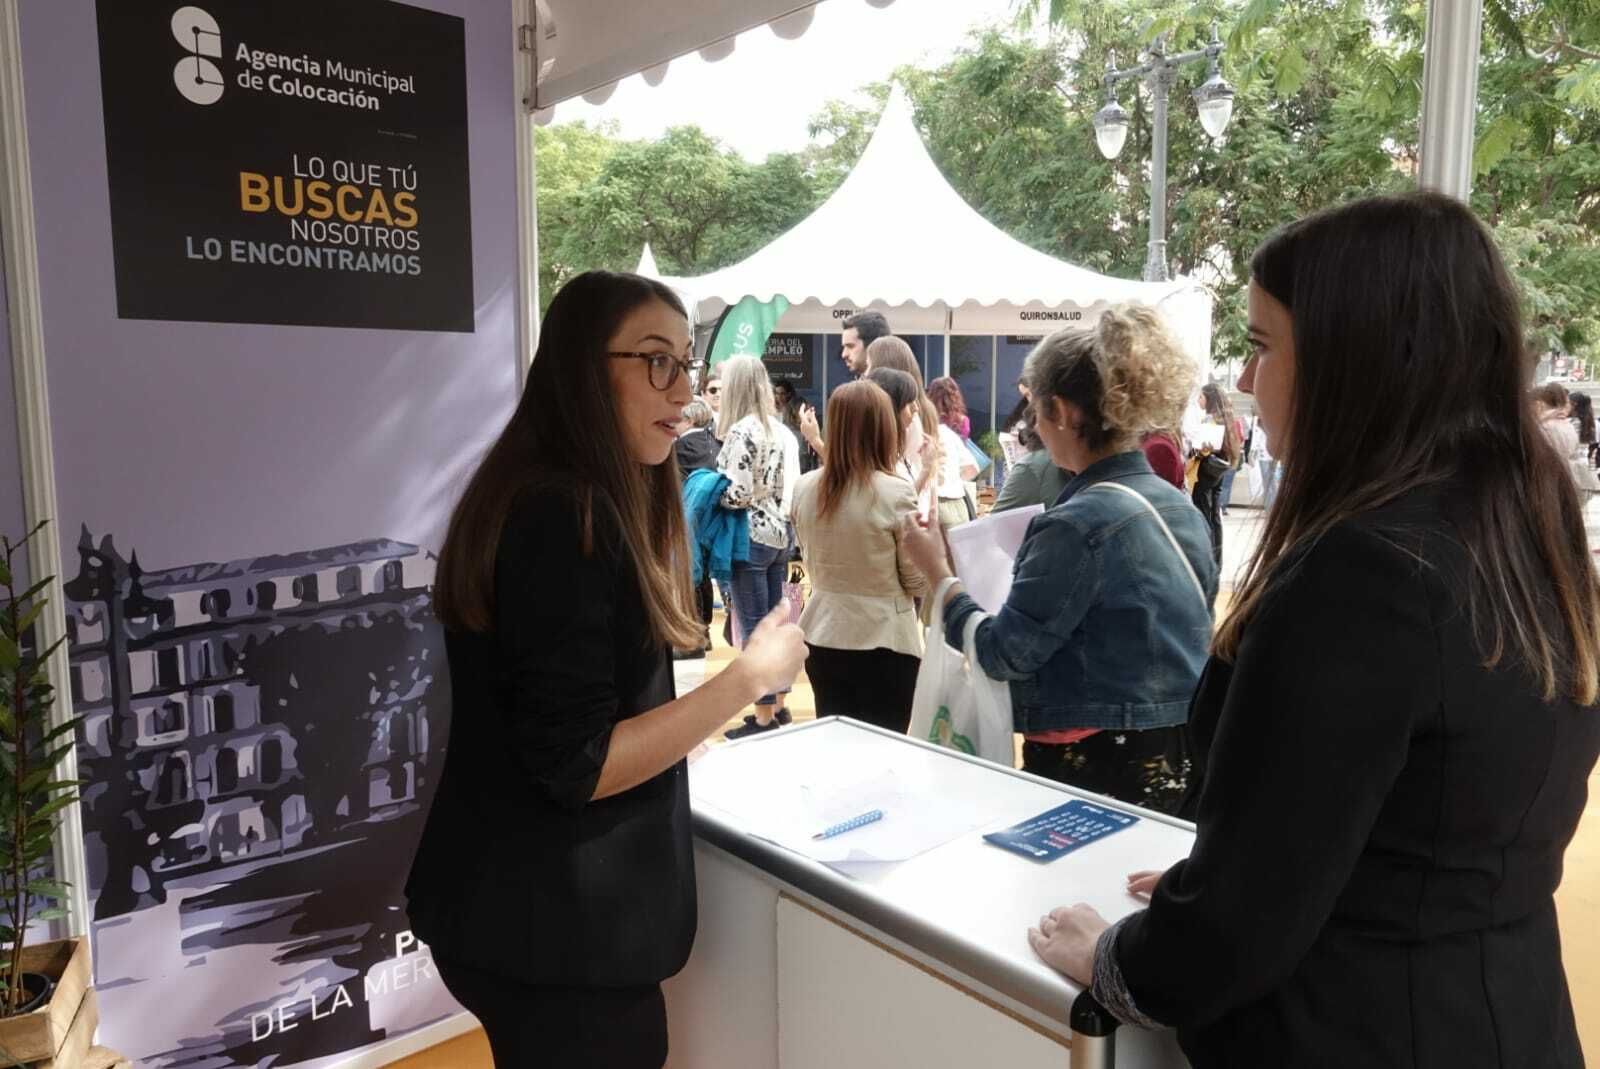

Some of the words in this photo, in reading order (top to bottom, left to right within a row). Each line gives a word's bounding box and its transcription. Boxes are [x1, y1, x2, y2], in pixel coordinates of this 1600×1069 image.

[236, 43, 321, 76] Agencia
[326, 60, 415, 94] Municipal
[237, 69, 264, 90] de
[269, 74, 379, 110] Colocación
[293, 154, 325, 180] LO
[332, 160, 381, 187] QUE
[388, 165, 417, 190] TÚ
[239, 171, 418, 227] BUSCAS
[291, 218, 420, 251] NOSOTROS
[186, 236, 221, 260] LO
[230, 240, 421, 276] ENCONTRAMOS
[1020, 311, 1082, 321] QUIRONSALUD
[251, 1002, 298, 1042] DE
[312, 984, 353, 1021] LA
[364, 955, 432, 1001] MER
